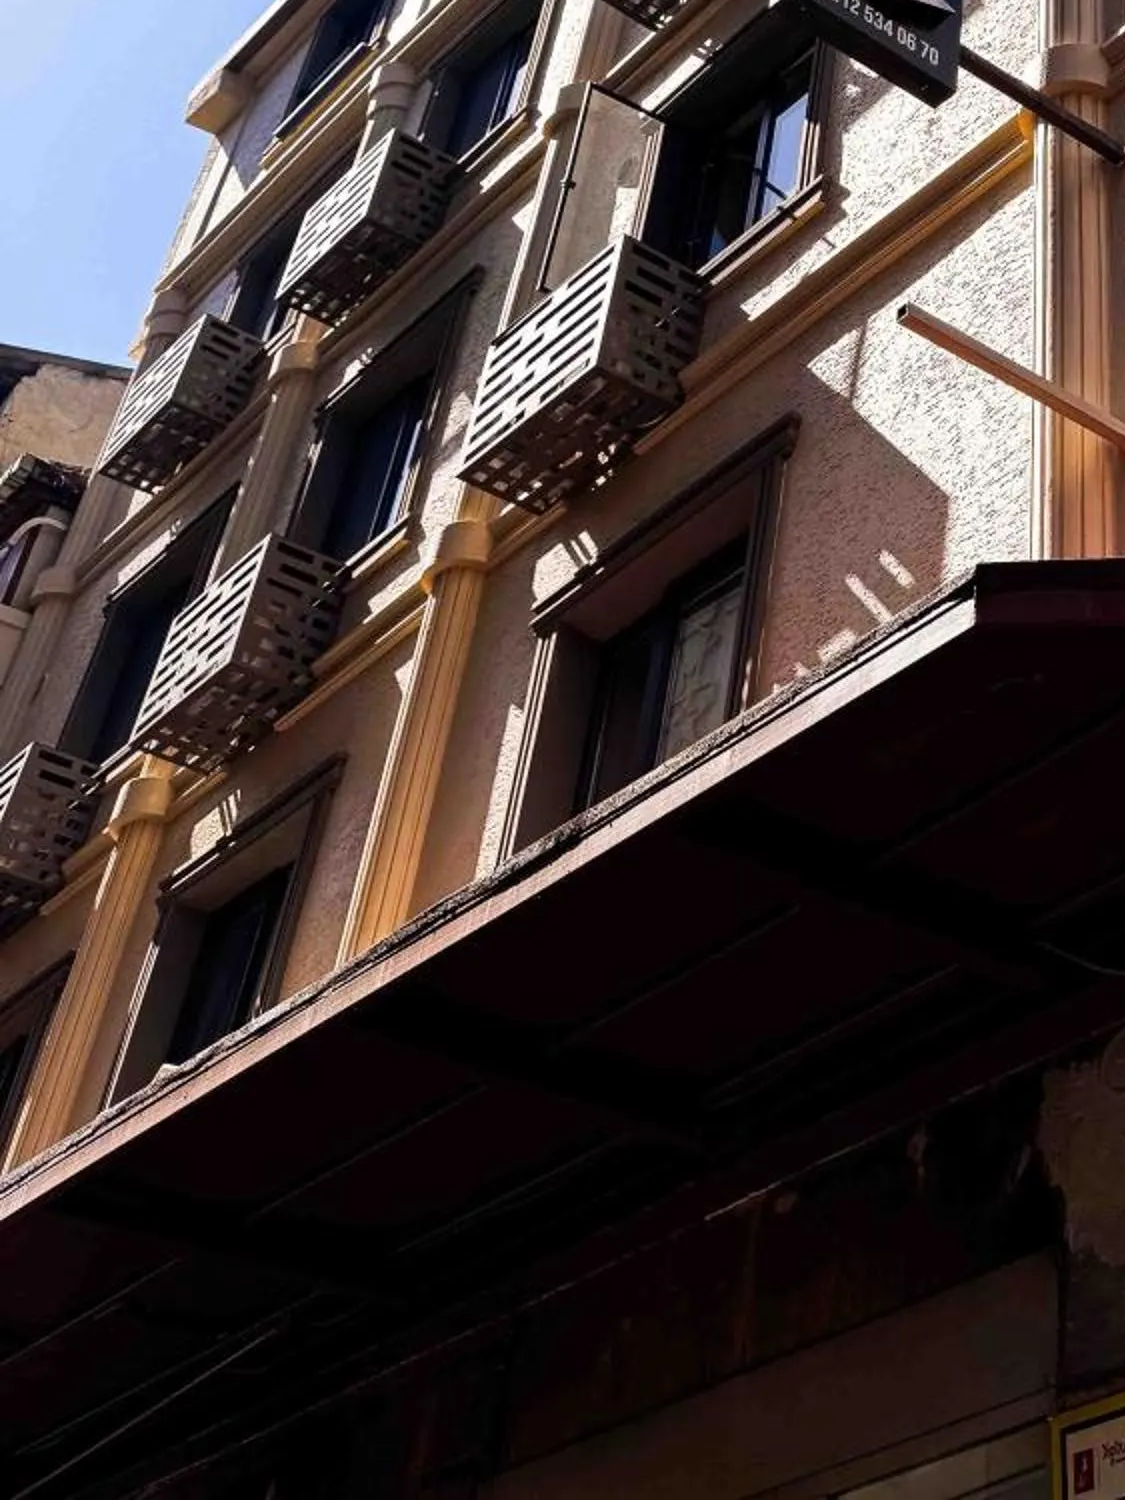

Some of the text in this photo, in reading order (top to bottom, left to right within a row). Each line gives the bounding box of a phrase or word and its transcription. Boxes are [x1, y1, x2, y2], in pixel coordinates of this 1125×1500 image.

[863, 4, 894, 37] 534
[897, 26, 917, 51] 06
[920, 40, 940, 66] 70
